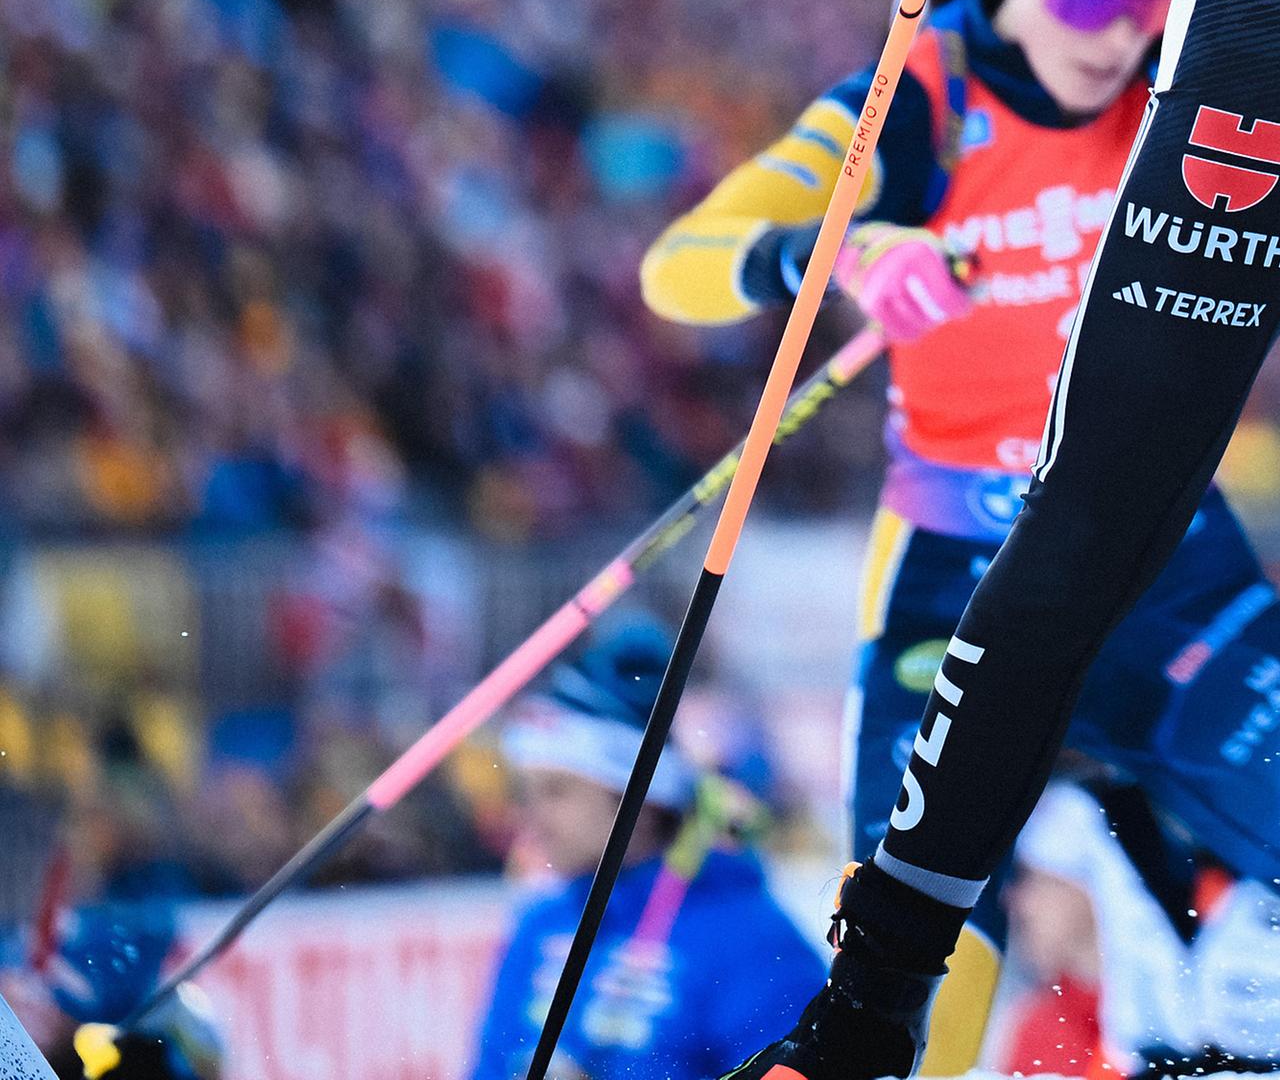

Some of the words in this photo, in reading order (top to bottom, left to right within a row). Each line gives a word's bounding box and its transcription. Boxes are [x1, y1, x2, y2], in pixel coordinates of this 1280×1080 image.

[844, 105, 878, 178] PREMIO
[873, 74, 889, 98] 40
[1154, 285, 1267, 327] TERREX
